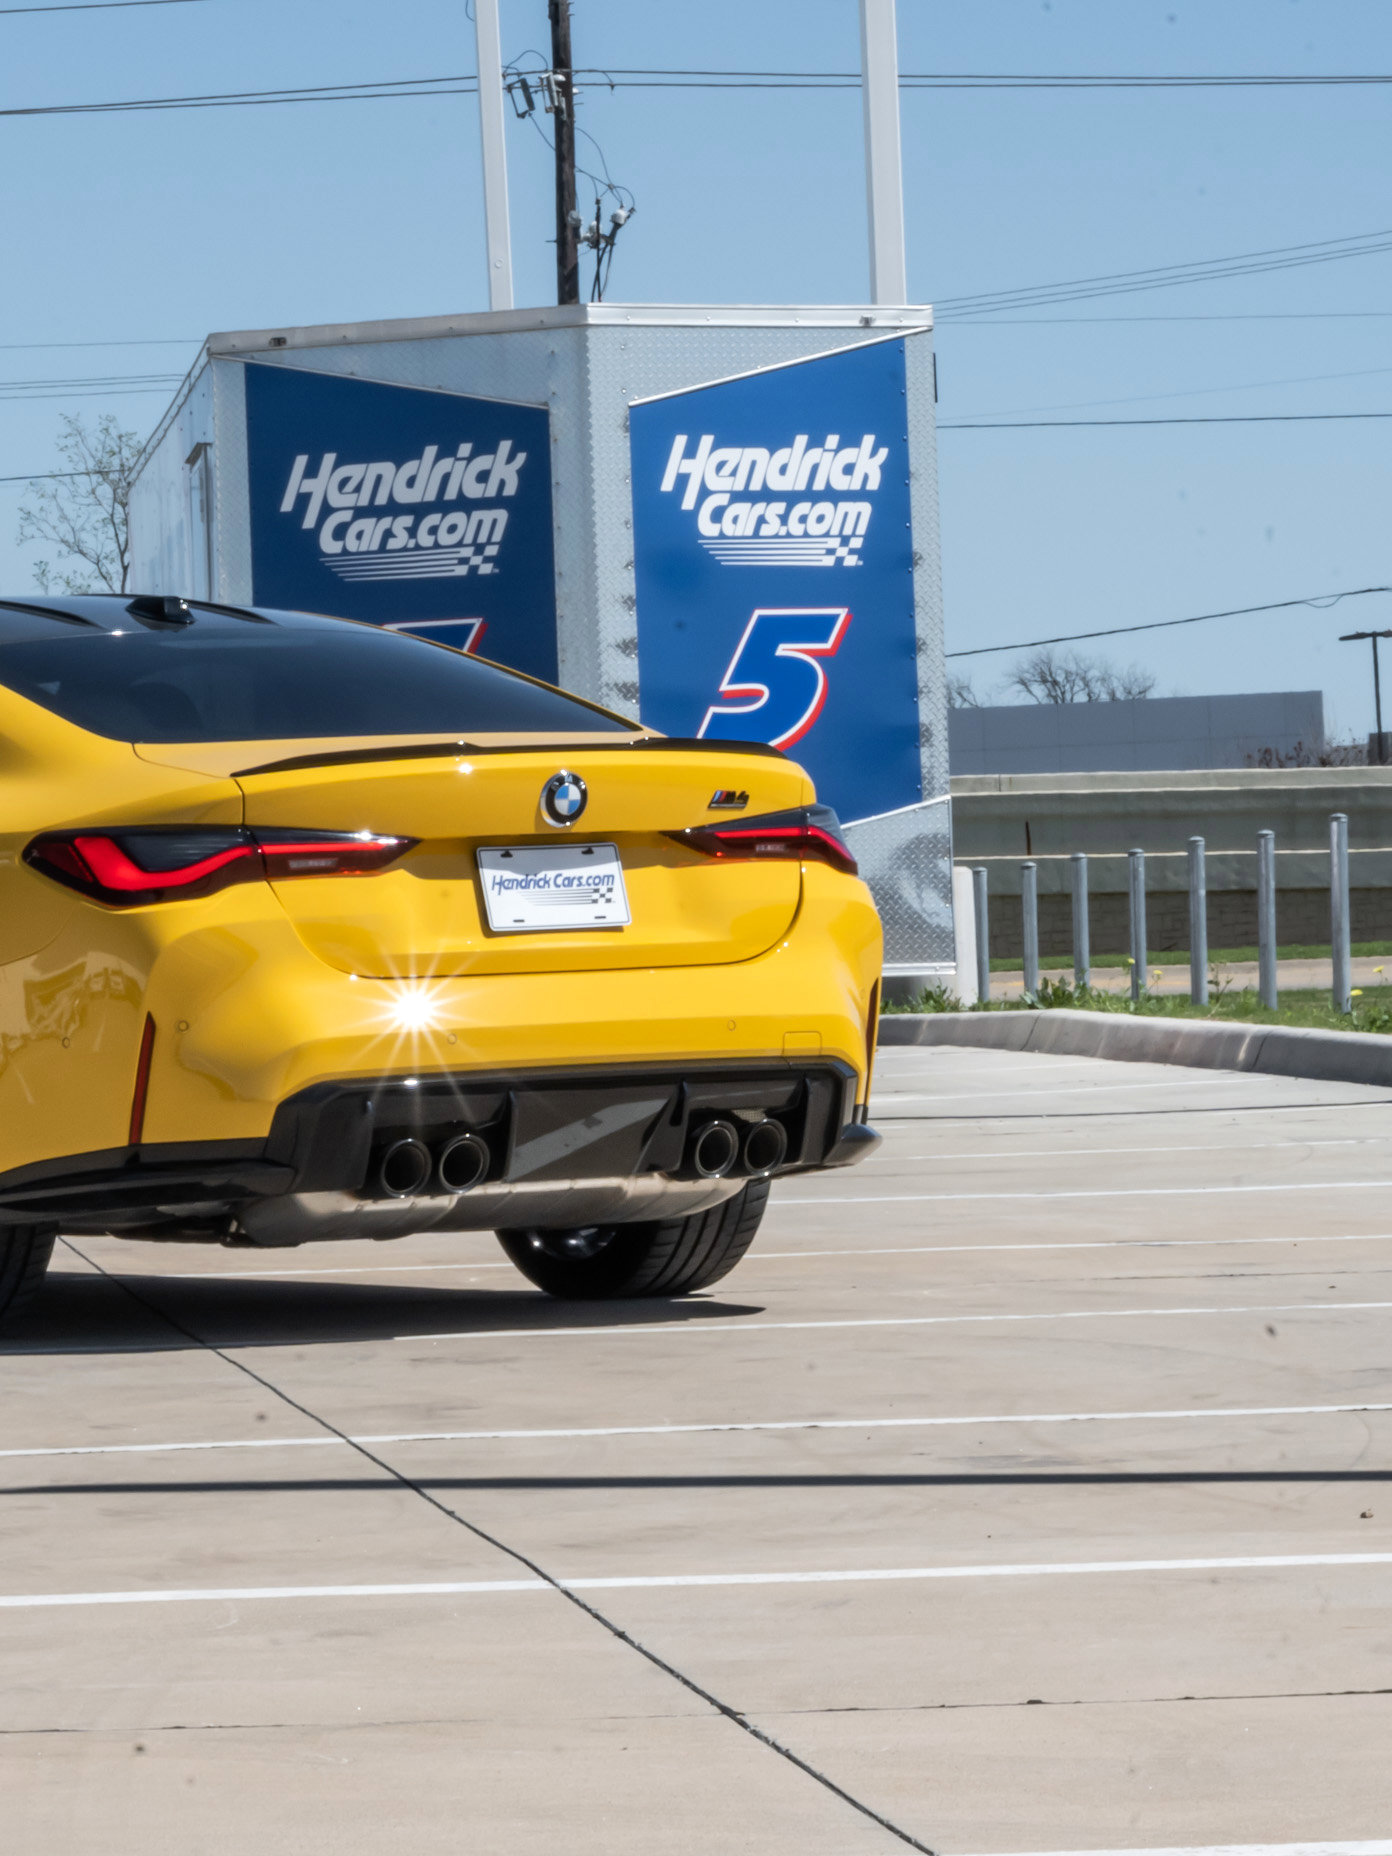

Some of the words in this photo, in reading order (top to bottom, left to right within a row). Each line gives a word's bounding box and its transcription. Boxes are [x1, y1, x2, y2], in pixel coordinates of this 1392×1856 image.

[279, 440, 527, 529] Hendrick
[660, 434, 889, 510] Hendrick
[319, 508, 509, 554] Cars.com
[697, 493, 872, 537] Cars.com
[696, 607, 853, 750] 5
[491, 873, 551, 896] Hendrick
[553, 873, 615, 888] Cars.com
